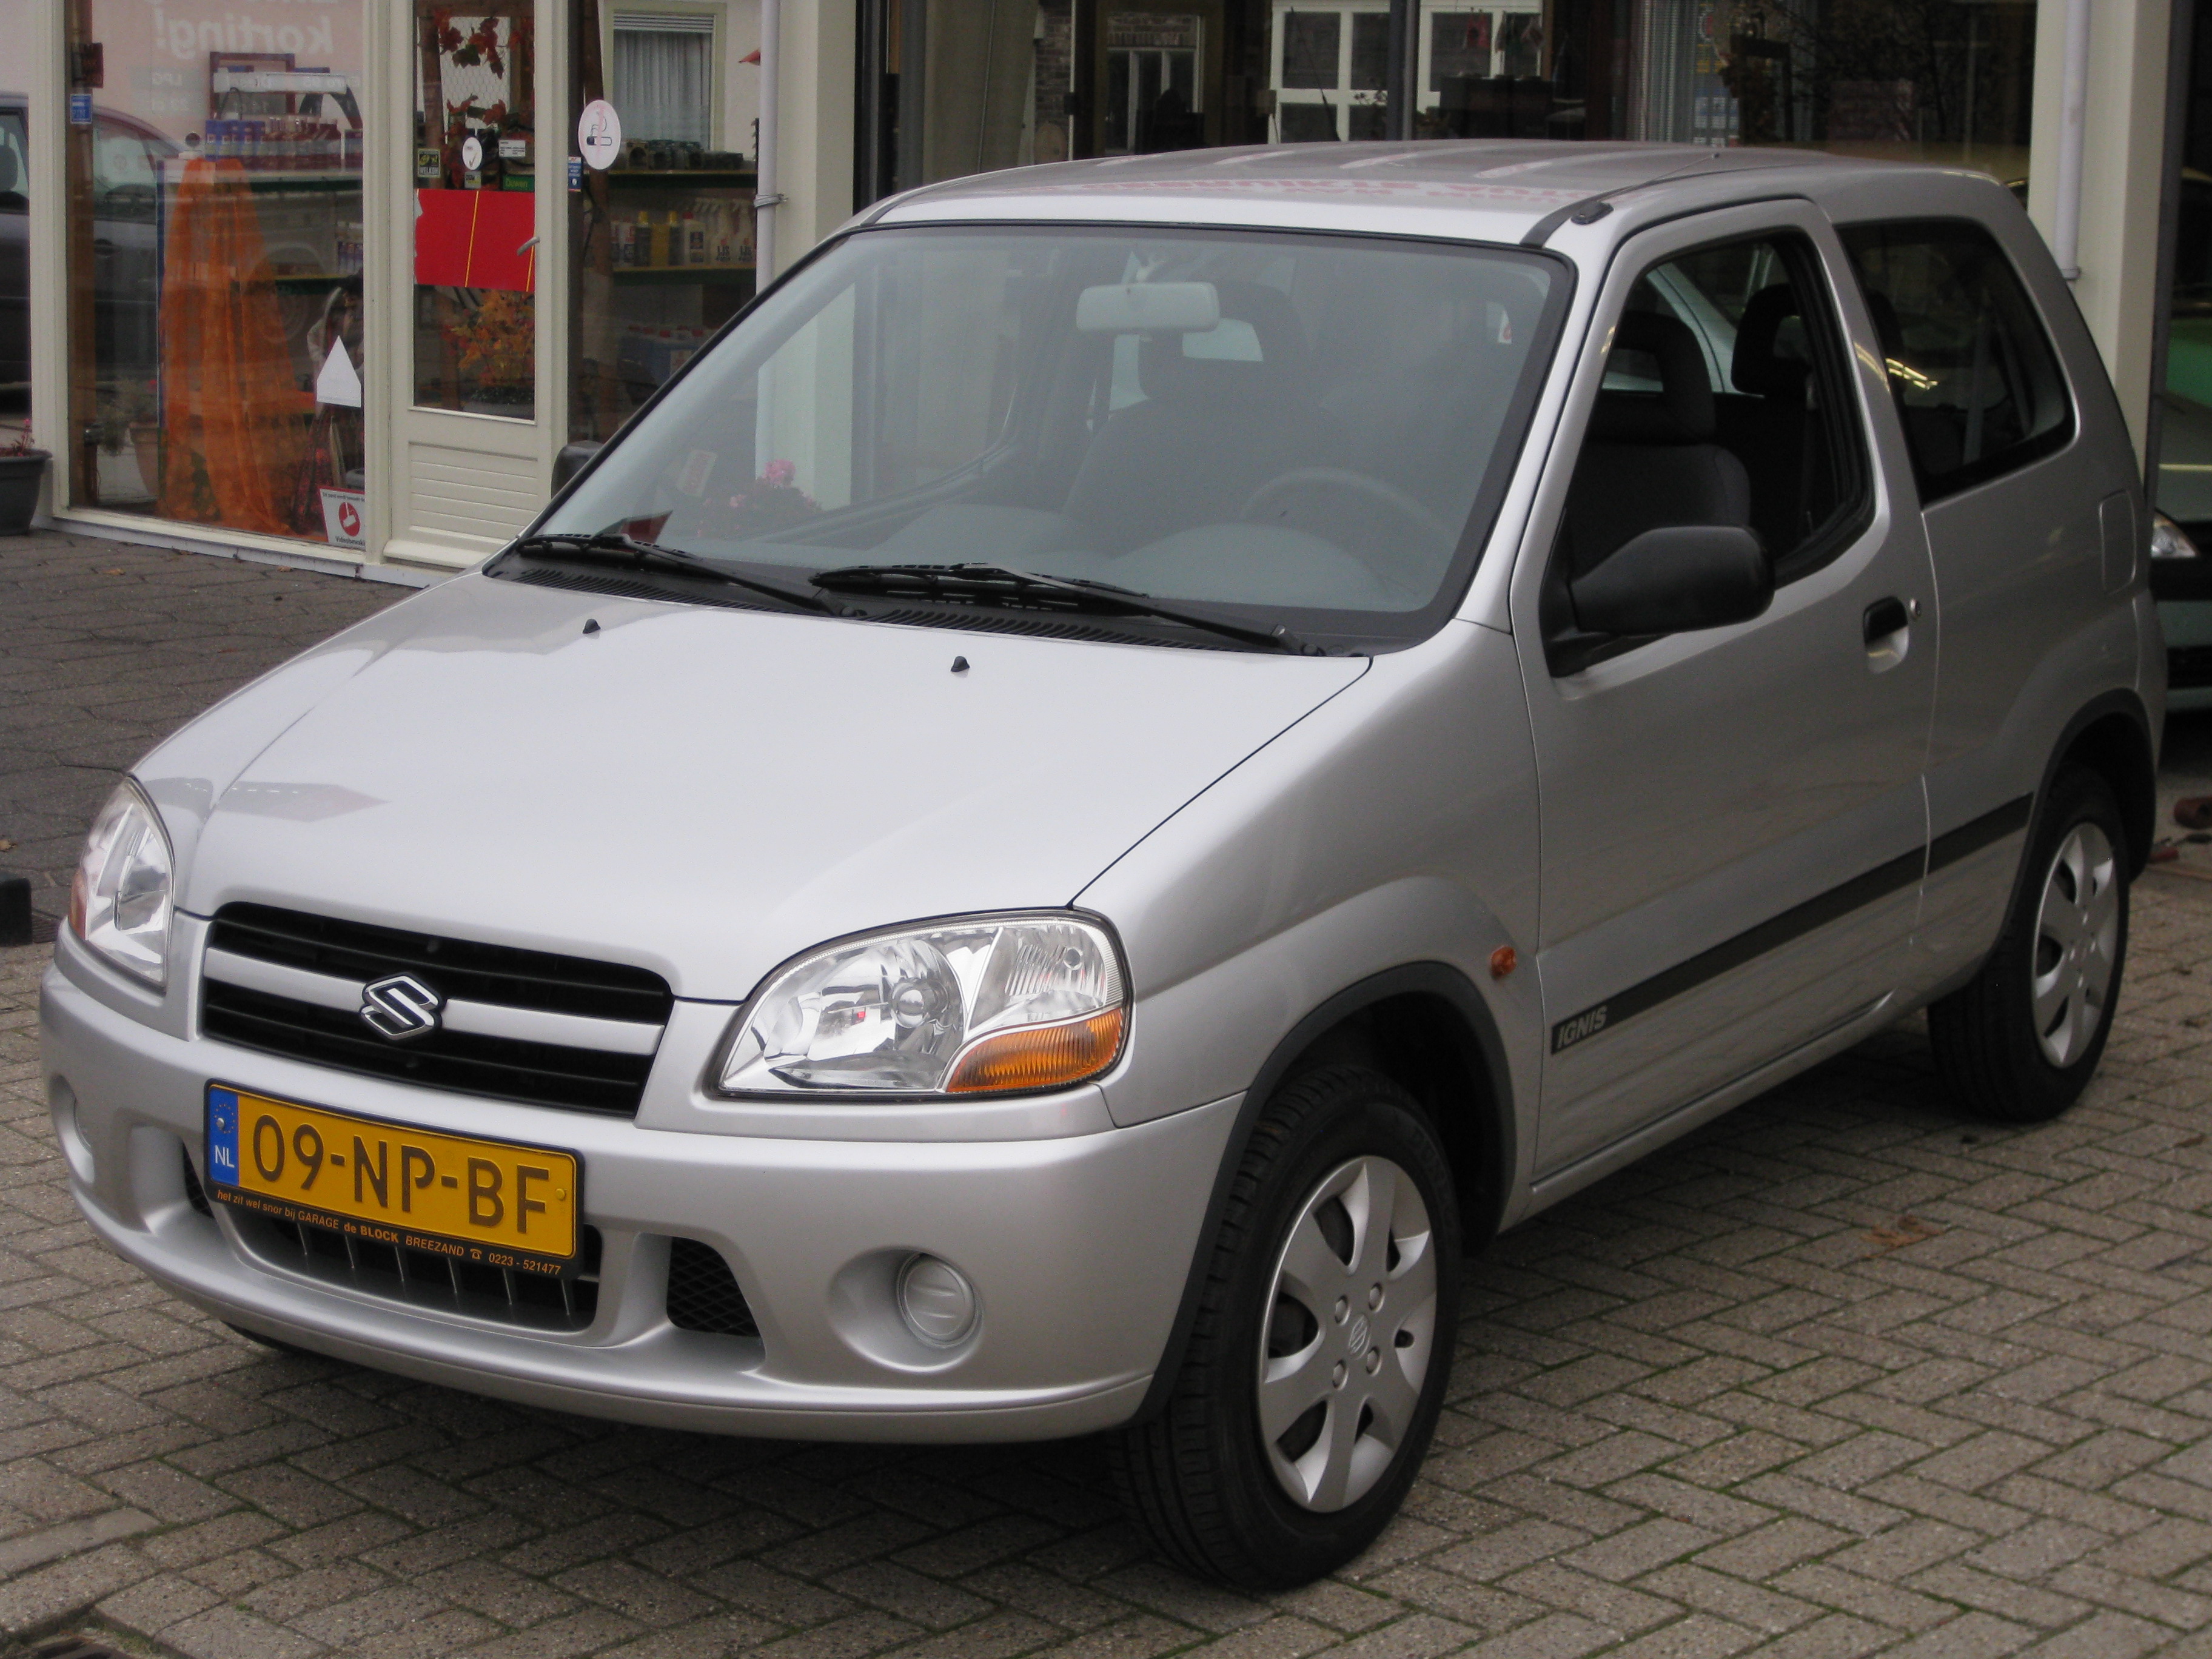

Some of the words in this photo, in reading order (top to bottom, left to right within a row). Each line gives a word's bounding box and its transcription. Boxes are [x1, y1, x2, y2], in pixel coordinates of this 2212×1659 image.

[1557, 1004, 1608, 1049] IGNIS
[214, 1144, 235, 1169] NL
[252, 1113, 550, 1235] 09-NP-BF
[217, 1189, 231, 1201] het
[233, 1195, 244, 1205] zit
[246, 1199, 261, 1209] wel
[263, 1203, 283, 1215] snor
[284, 1207, 296, 1221] bij
[298, 1211, 340, 1230] GARAGE
[344, 1222, 357, 1233] de
[360, 1225, 400, 1243] BLOCK
[405, 1235, 465, 1256] BREEZAND
[489, 1253, 514, 1267] 0223
[523, 1259, 562, 1275] 521477
